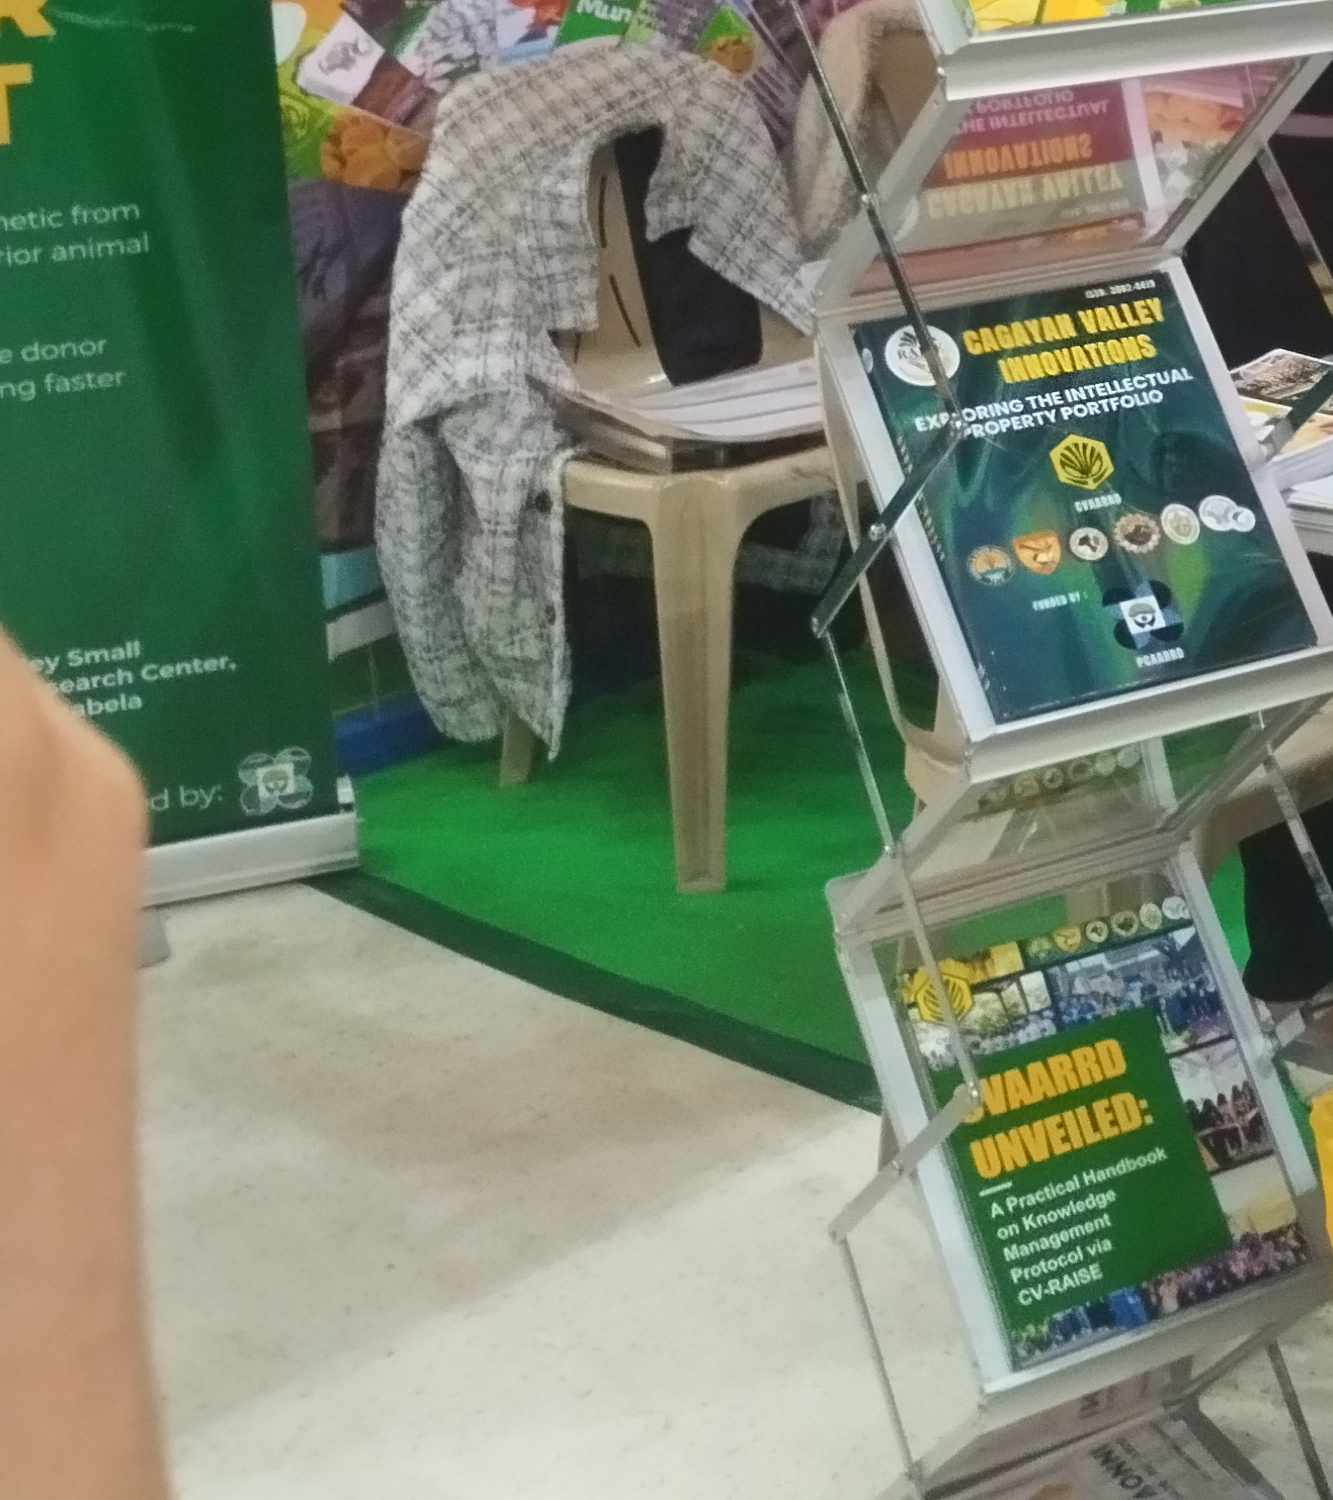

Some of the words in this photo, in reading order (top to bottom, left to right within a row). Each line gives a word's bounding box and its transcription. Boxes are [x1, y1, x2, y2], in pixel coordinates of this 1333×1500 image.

[71, 204, 140, 226] from
[0, 244, 42, 269] ior
[52, 231, 149, 262] animal
[962, 313, 1078, 356] CAGAYAN
[1077, 296, 1164, 335] VALLEY
[20, 338, 108, 363] donor
[997, 333, 1158, 384] INNOVATIONS
[44, 370, 127, 393] faster
[914, 398, 1025, 433] EXPORING
[1025, 390, 1064, 411] THE
[1064, 367, 1194, 403] INTELLECTUAL
[1060, 390, 1164, 422] PORTFOLIO
[66, 640, 141, 668] Small
[140, 655, 237, 682] Center.
[179, 783, 223, 810] by:
[962, 1037, 1128, 1124] VAARRD
[969, 1092, 1156, 1180] UNVEILED:
[990, 1200, 1005, 1219] A
[1005, 1175, 1081, 1214] Practical
[1083, 1145, 1169, 1185] Handbook
[996, 1220, 1021, 1241] on
[1023, 1186, 1118, 1233] Knowledge
[1002, 1212, 1113, 1263] Management
[1009, 1246, 1085, 1285] Protocol
[1086, 1235, 1114, 1257] via
[1017, 1262, 1104, 1307] CV-RAISE
